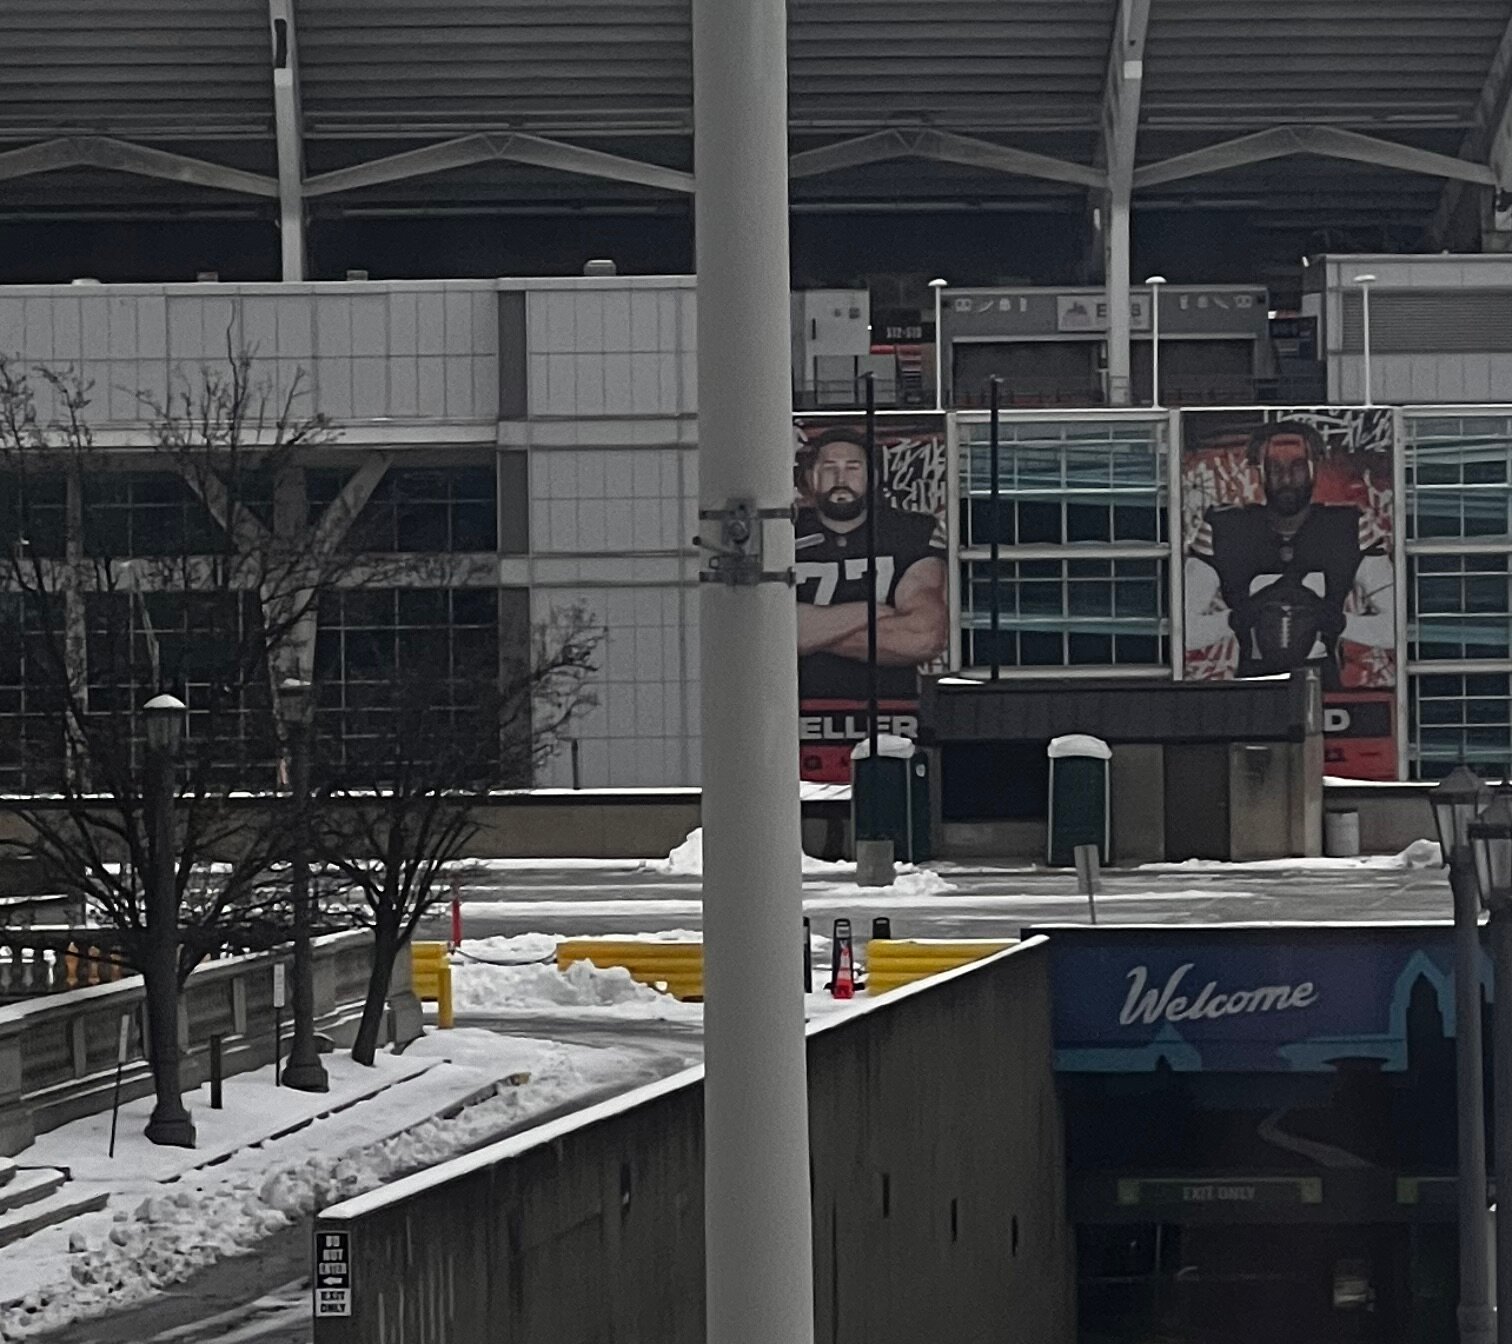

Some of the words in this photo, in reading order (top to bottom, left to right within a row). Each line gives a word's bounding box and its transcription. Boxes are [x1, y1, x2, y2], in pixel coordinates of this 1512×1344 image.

[800, 714, 918, 740] ELLER
[1119, 962, 1320, 1025] Welcome
[1217, 1185, 1255, 1200] ONLY
